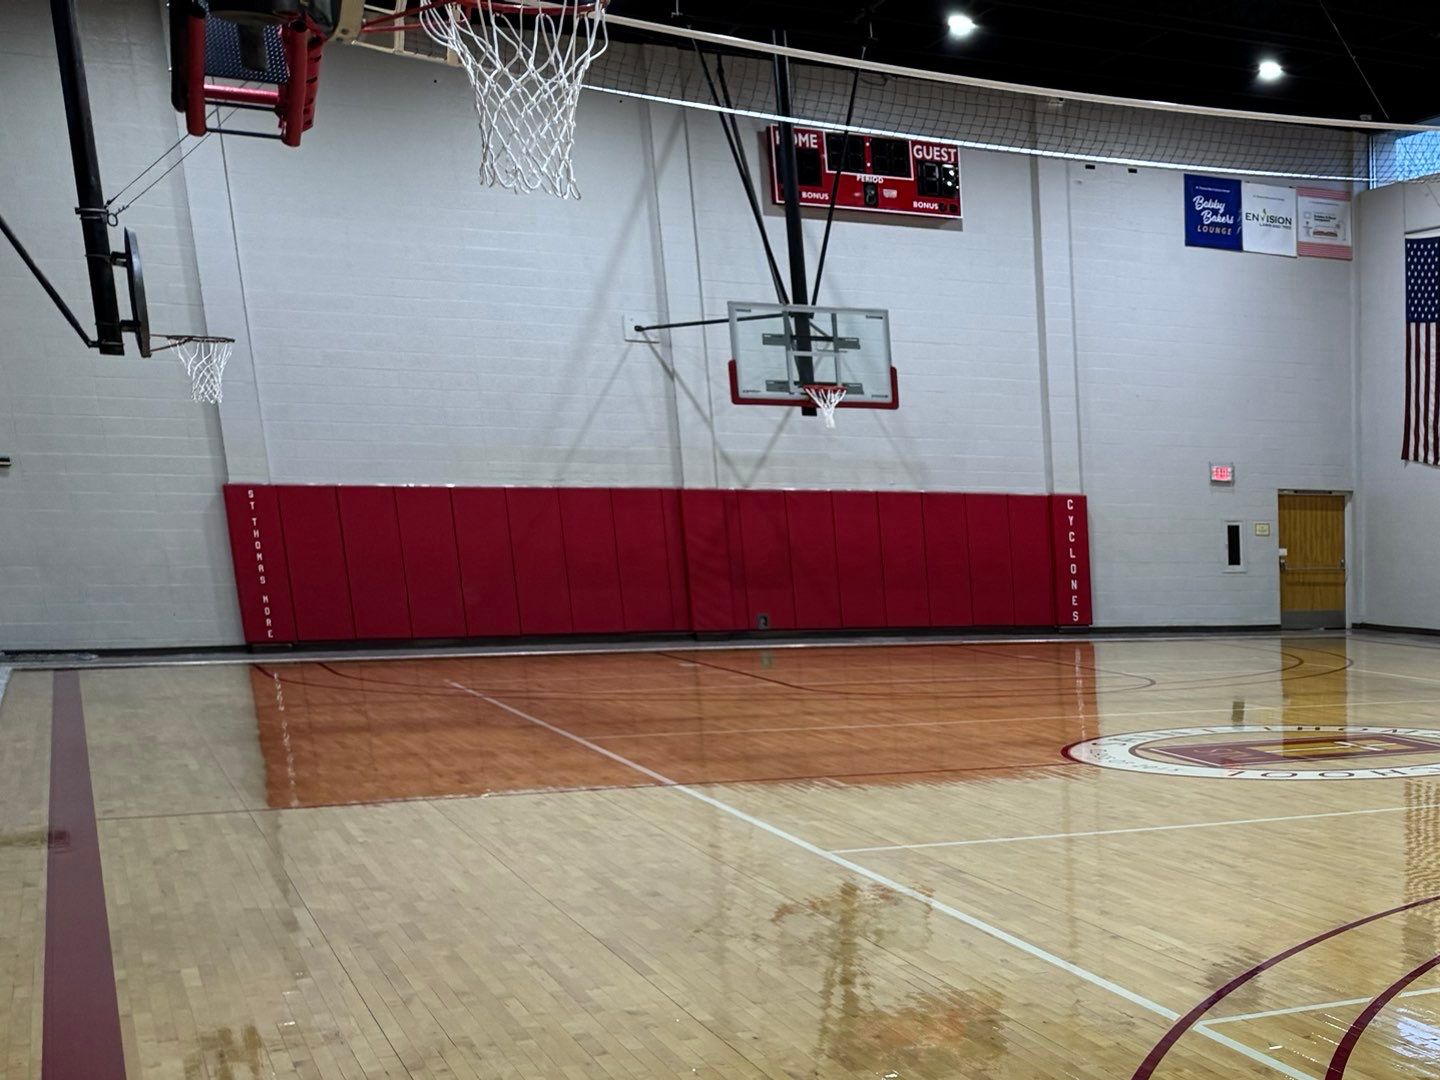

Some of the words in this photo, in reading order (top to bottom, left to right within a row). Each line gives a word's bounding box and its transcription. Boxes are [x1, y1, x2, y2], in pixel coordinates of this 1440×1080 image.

[913, 145, 957, 162] GUEST
[856, 174, 884, 184] PERIOD
[801, 191, 829, 201] BONUS
[1193, 195, 1226, 214] Bobby
[913, 201, 939, 210] BONUS
[1245, 208, 1292, 226] ENVISION
[1197, 225, 1232, 235] LOUNGE
[1067, 499, 1079, 622] CYCLONES
[252, 517, 266, 585] THOMAS
[263, 595, 274, 639] MORE
